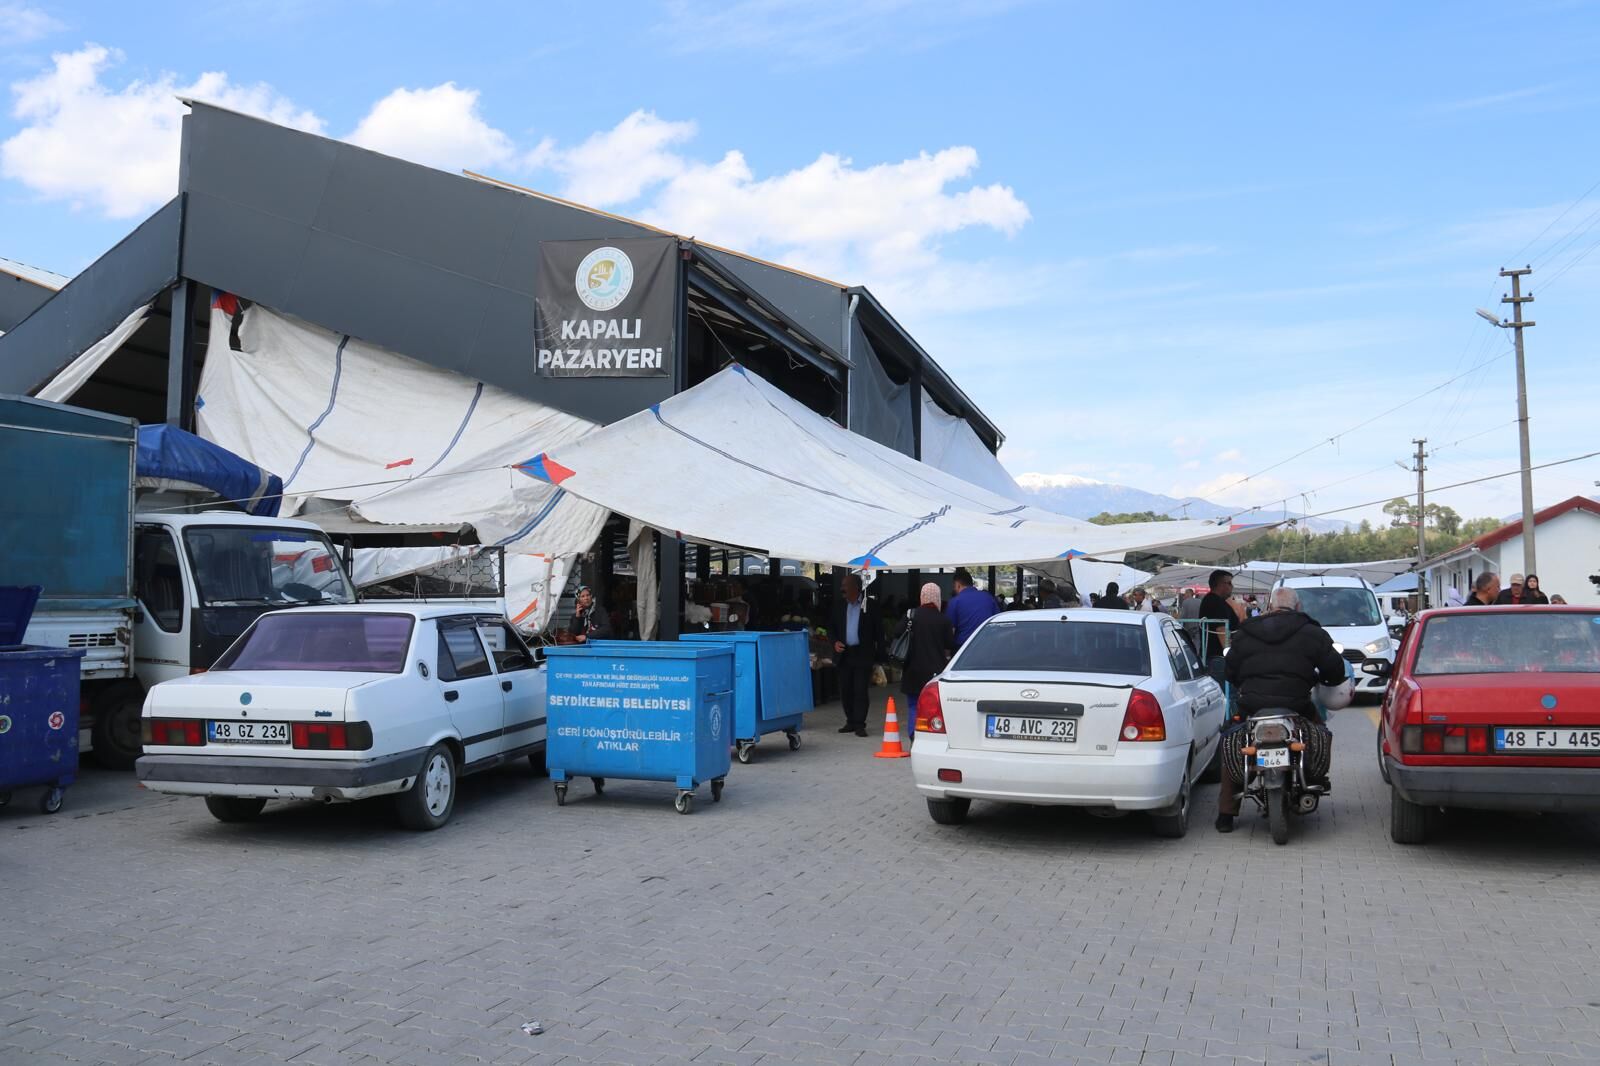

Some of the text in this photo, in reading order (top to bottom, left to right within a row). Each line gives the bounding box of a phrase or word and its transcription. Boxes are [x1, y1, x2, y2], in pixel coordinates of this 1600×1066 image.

[561, 318, 642, 340] KAPALI
[550, 694, 690, 711] SEYDİKEMER BELEDİYESİ
[216, 724, 286, 739] 48 GZ 234
[558, 726, 581, 737] GERİ
[995, 718, 1074, 736] 48 AVC 232
[597, 741, 640, 752] ATIKLAR
[1505, 731, 1600, 747] 48 FJ 445
